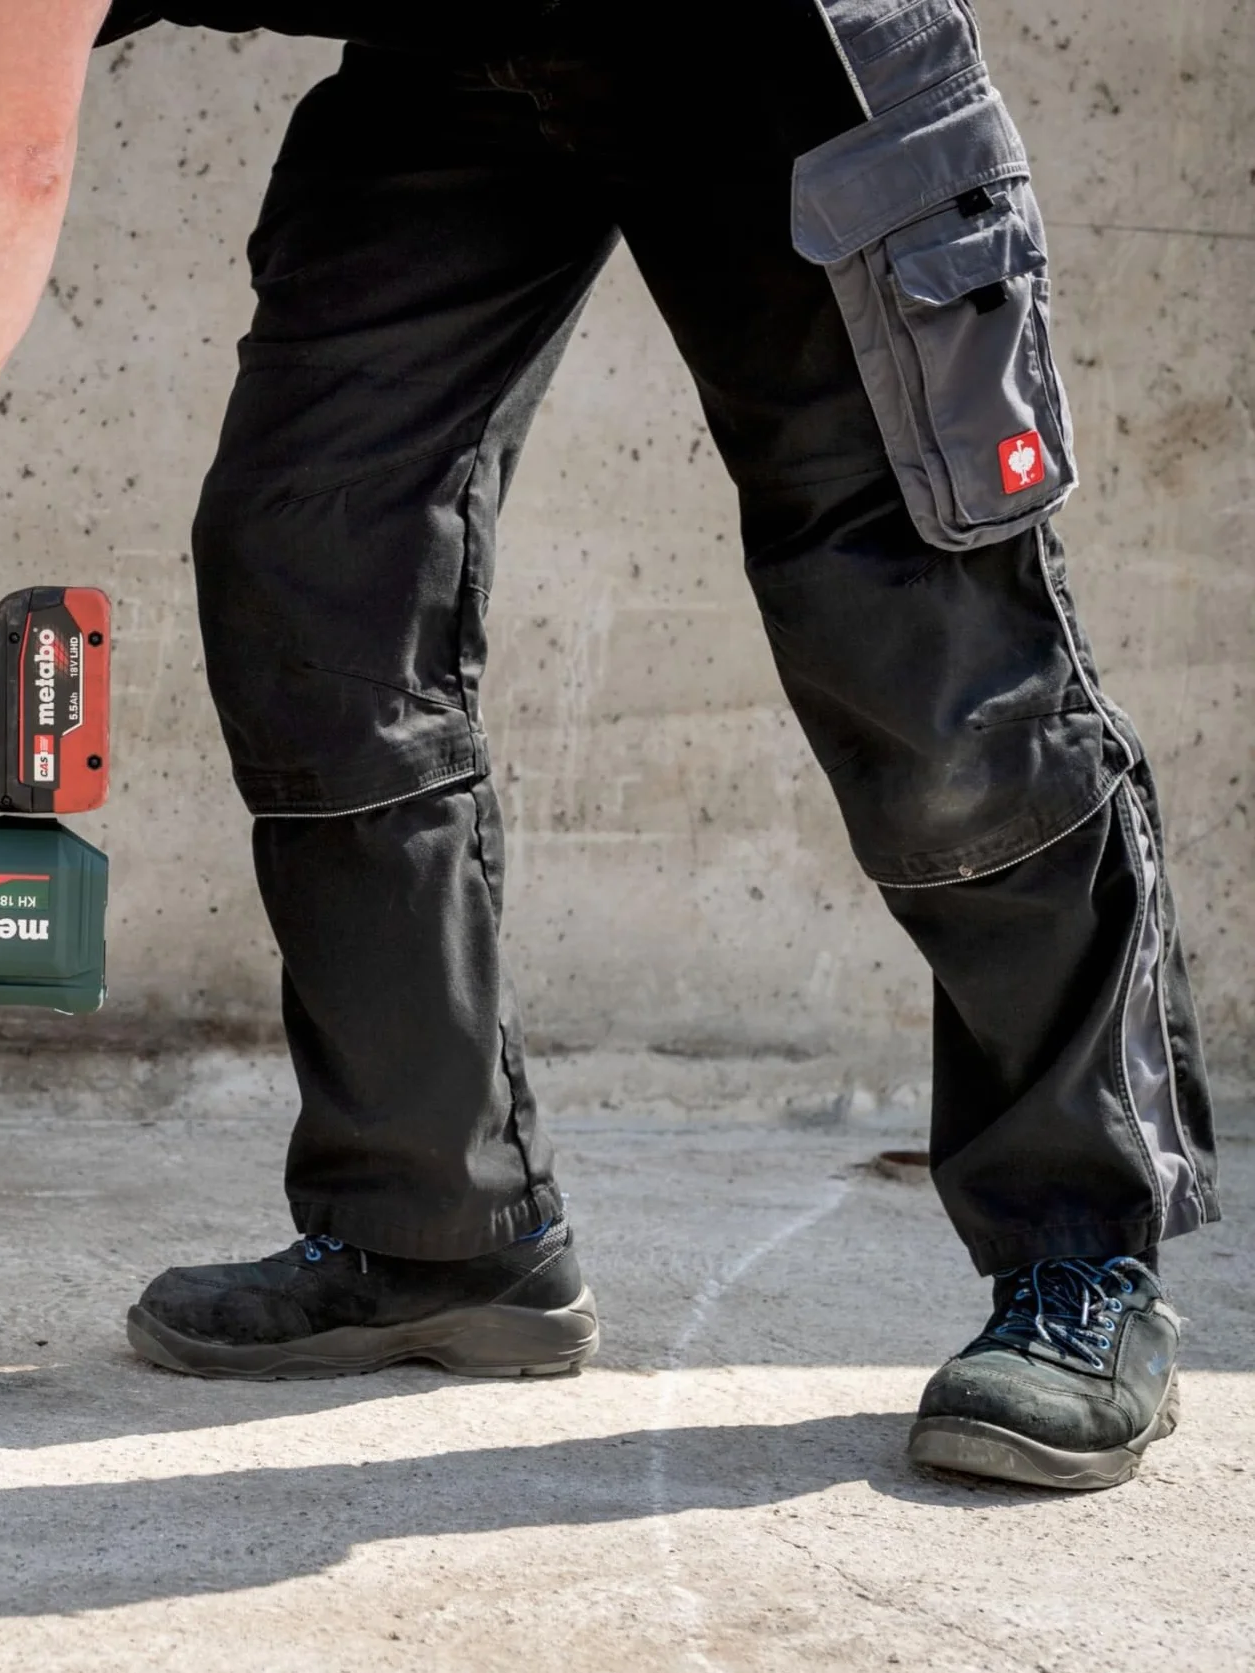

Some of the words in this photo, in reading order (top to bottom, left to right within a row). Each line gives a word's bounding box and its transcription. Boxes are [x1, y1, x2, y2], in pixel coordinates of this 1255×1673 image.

[34, 630, 55, 726] metabo
[70, 660, 78, 678] 18V
[69, 692, 78, 720] 5.5Ah
[40, 757, 49, 778] CAS
[0, 895, 14, 906] 18
[18, 895, 36, 907] KH
